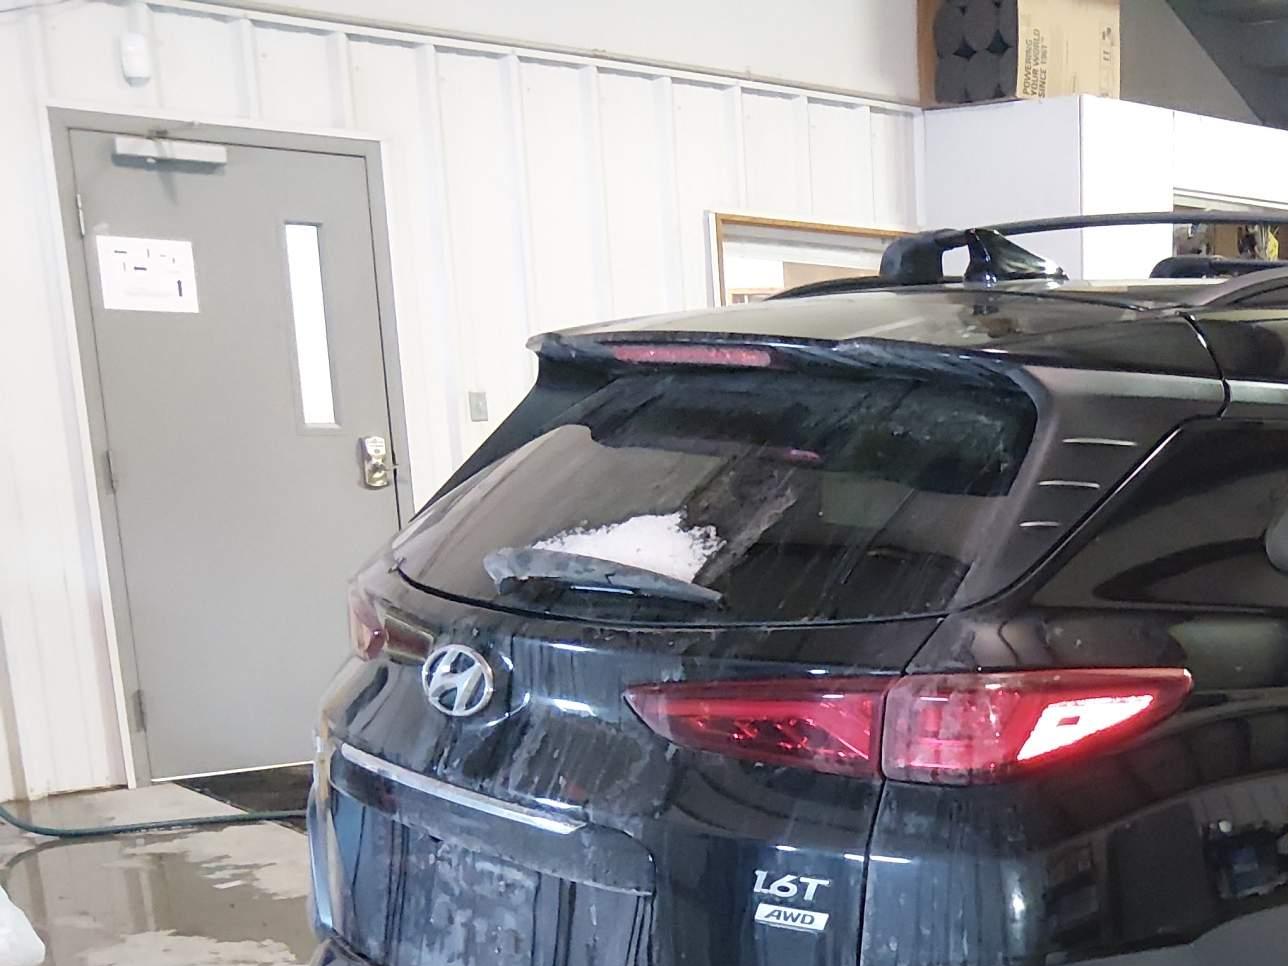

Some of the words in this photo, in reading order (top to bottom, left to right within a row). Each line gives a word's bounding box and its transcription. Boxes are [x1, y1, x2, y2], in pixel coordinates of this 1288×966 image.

[1033, 28, 1041, 67] WORLD
[1023, 39, 1033, 96] POWERING
[1030, 68, 1040, 97] YOUR
[1038, 69, 1047, 98] SINCE
[764, 909, 815, 925] AWD
